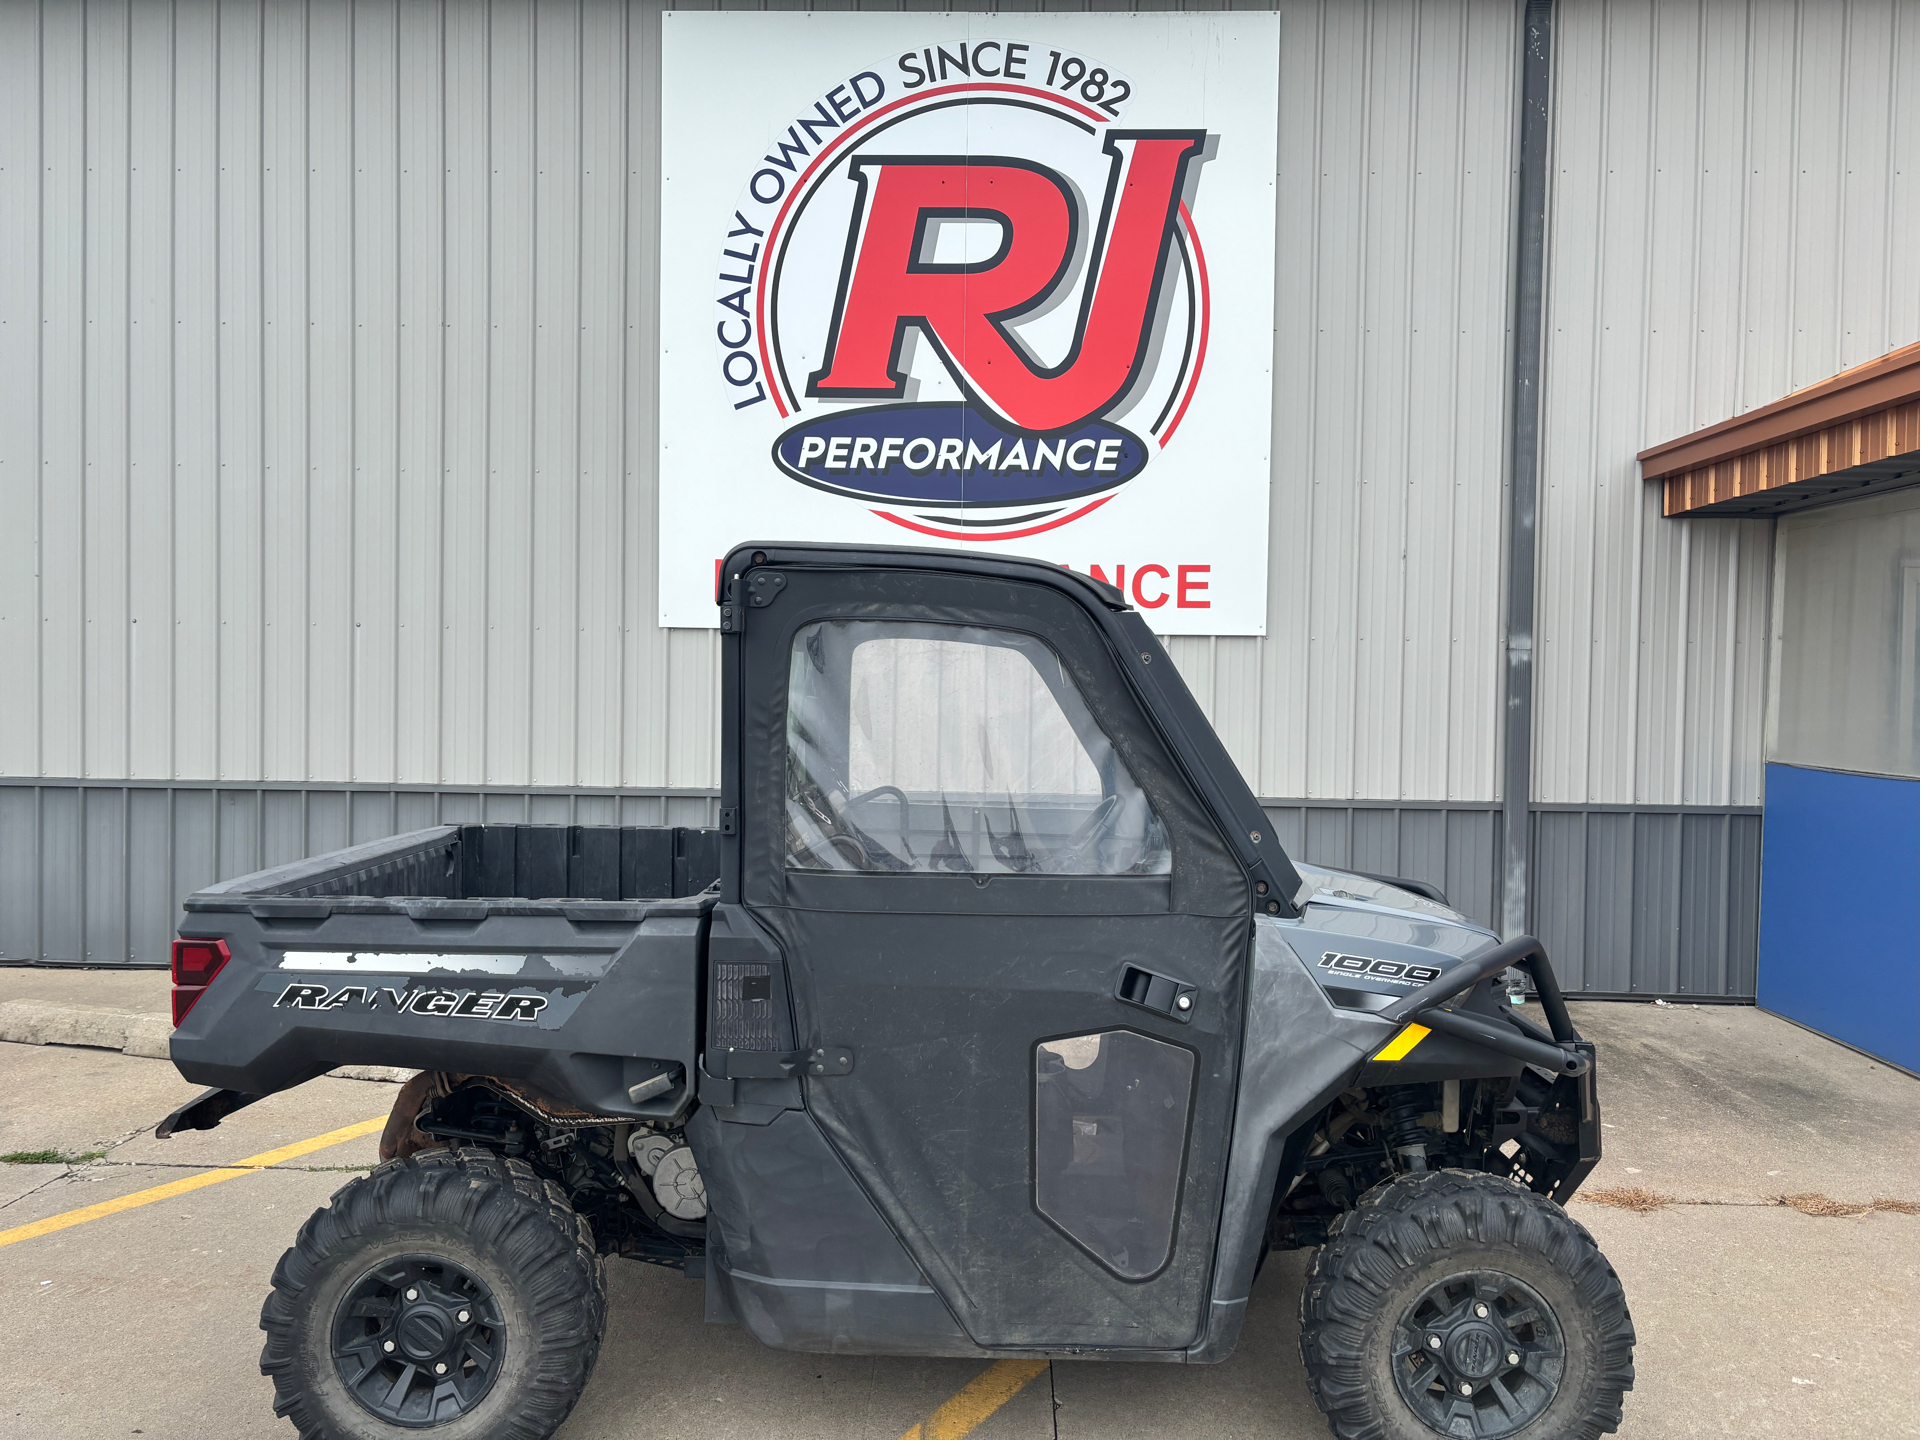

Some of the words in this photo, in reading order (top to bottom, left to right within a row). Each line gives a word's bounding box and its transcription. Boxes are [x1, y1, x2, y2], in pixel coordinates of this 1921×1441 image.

[716, 209, 766, 410] LOCALLY
[750, 71, 885, 204] OWNED
[898, 41, 1029, 88] SINCE
[1044, 50, 1131, 117] 1982
[805, 129, 1210, 441] RJ
[798, 436, 1124, 471] PERFORMANCE
[1317, 951, 1442, 983] 1000
[1327, 969, 1362, 979] SINGLE
[1363, 975, 1411, 986] OVERHEAD
[273, 983, 548, 1021] RANGER
